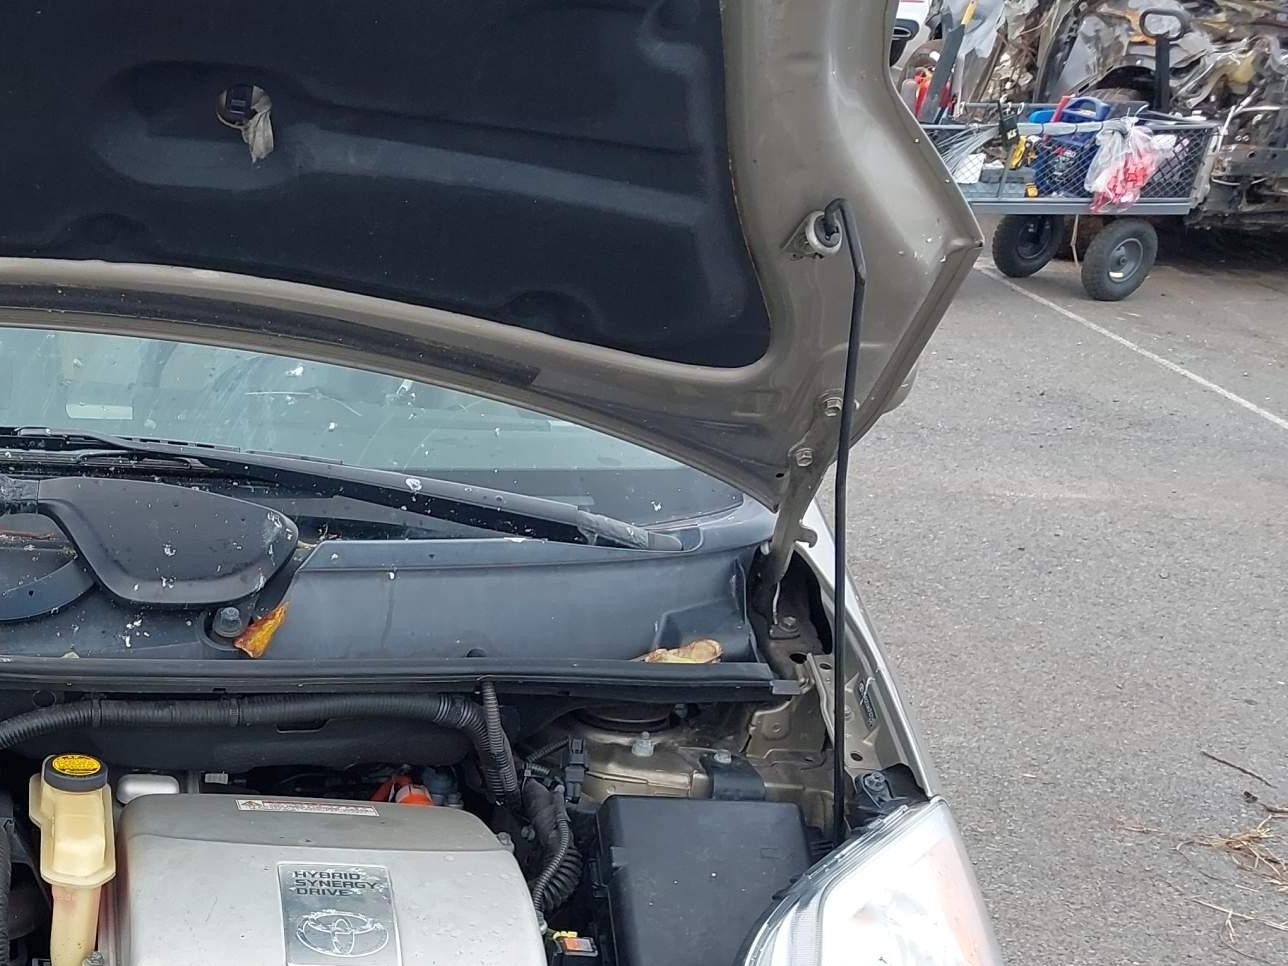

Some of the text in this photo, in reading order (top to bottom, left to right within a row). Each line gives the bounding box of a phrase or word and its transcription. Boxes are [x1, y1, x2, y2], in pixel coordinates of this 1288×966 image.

[294, 871, 360, 880] HYBRID
[295, 880, 377, 889] SYNERGY
[296, 888, 353, 897] DRIVE
